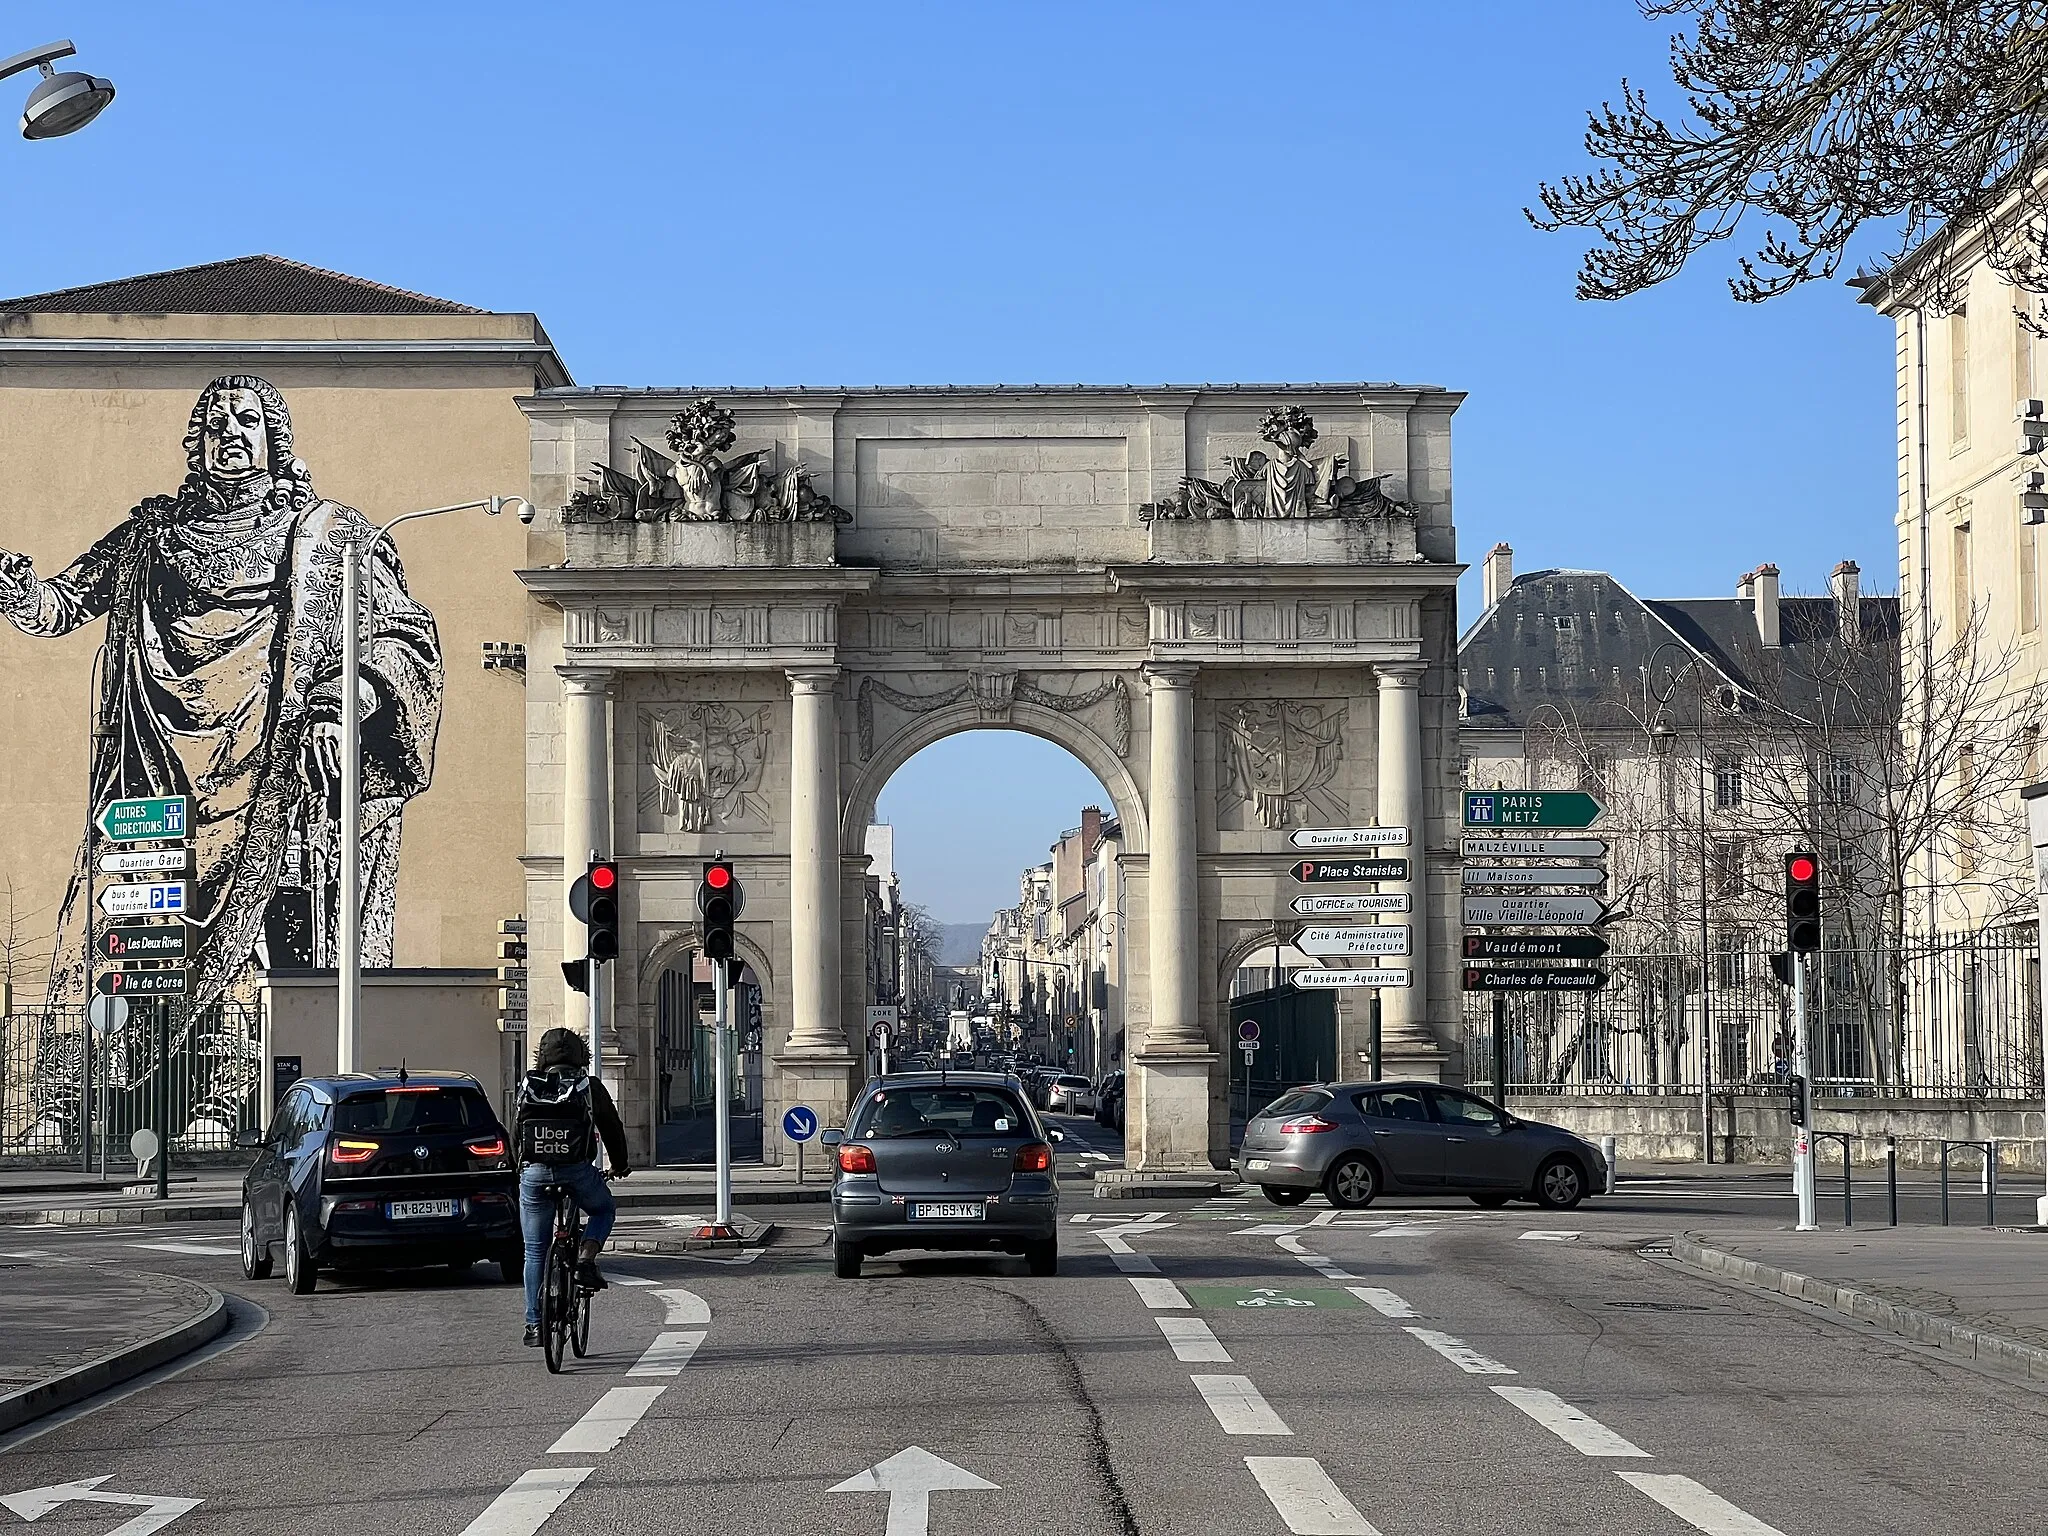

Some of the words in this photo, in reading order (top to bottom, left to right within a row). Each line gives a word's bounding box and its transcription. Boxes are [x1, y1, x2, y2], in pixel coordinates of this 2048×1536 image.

[1502, 796, 1543, 808] PARIS
[114, 805, 147, 820] AUTRES
[1502, 811, 1540, 823] METZ
[114, 820, 162, 836] DIRECTIONS
[1311, 835, 1348, 844] Quartier
[1352, 832, 1404, 843] Stanislas
[1467, 841, 1545, 853] MALZÉVILLE
[119, 858, 154, 869] Quartier
[158, 853, 182, 867] Gare
[1302, 862, 1315, 881] P
[1319, 865, 1350, 878] Place
[1352, 864, 1404, 877] Stanislas
[1467, 872, 1480, 881] III
[1486, 871, 1534, 882] Maisons
[111, 889, 126, 899] bus
[129, 888, 140, 898] de
[112, 901, 149, 912] tourisme
[1315, 900, 1346, 910] OFFICE
[1358, 898, 1403, 909] TOURISME
[1501, 899, 1550, 909] Quartier
[1468, 909, 1493, 921] Ville
[1498, 909, 1584, 923] Vieille-Léopold
[1310, 930, 1330, 941] Cité
[1334, 929, 1404, 940] Administrative
[127, 937, 141, 950] Les
[141, 936, 161, 950] Deux
[161, 935, 183, 949] Rives
[1347, 941, 1404, 952] Préfecture
[1485, 942, 1562, 953] Vaudémont
[514, 946, 527, 955] Plac
[124, 974, 138, 990] Île
[141, 975, 153, 989] de
[155, 974, 183, 988] Corse
[1302, 973, 1405, 985] Muséum-Aquarium
[1484, 974, 1527, 985] Charles
[1530, 974, 1543, 985] de
[1547, 973, 1597, 985] Foucauld
[534, 1126, 570, 1140] Uber
[534, 1140, 570, 1154] Eats
[393, 1200, 451, 1216] FN-829-VH
[918, 1203, 973, 1217] BP-169-YK
